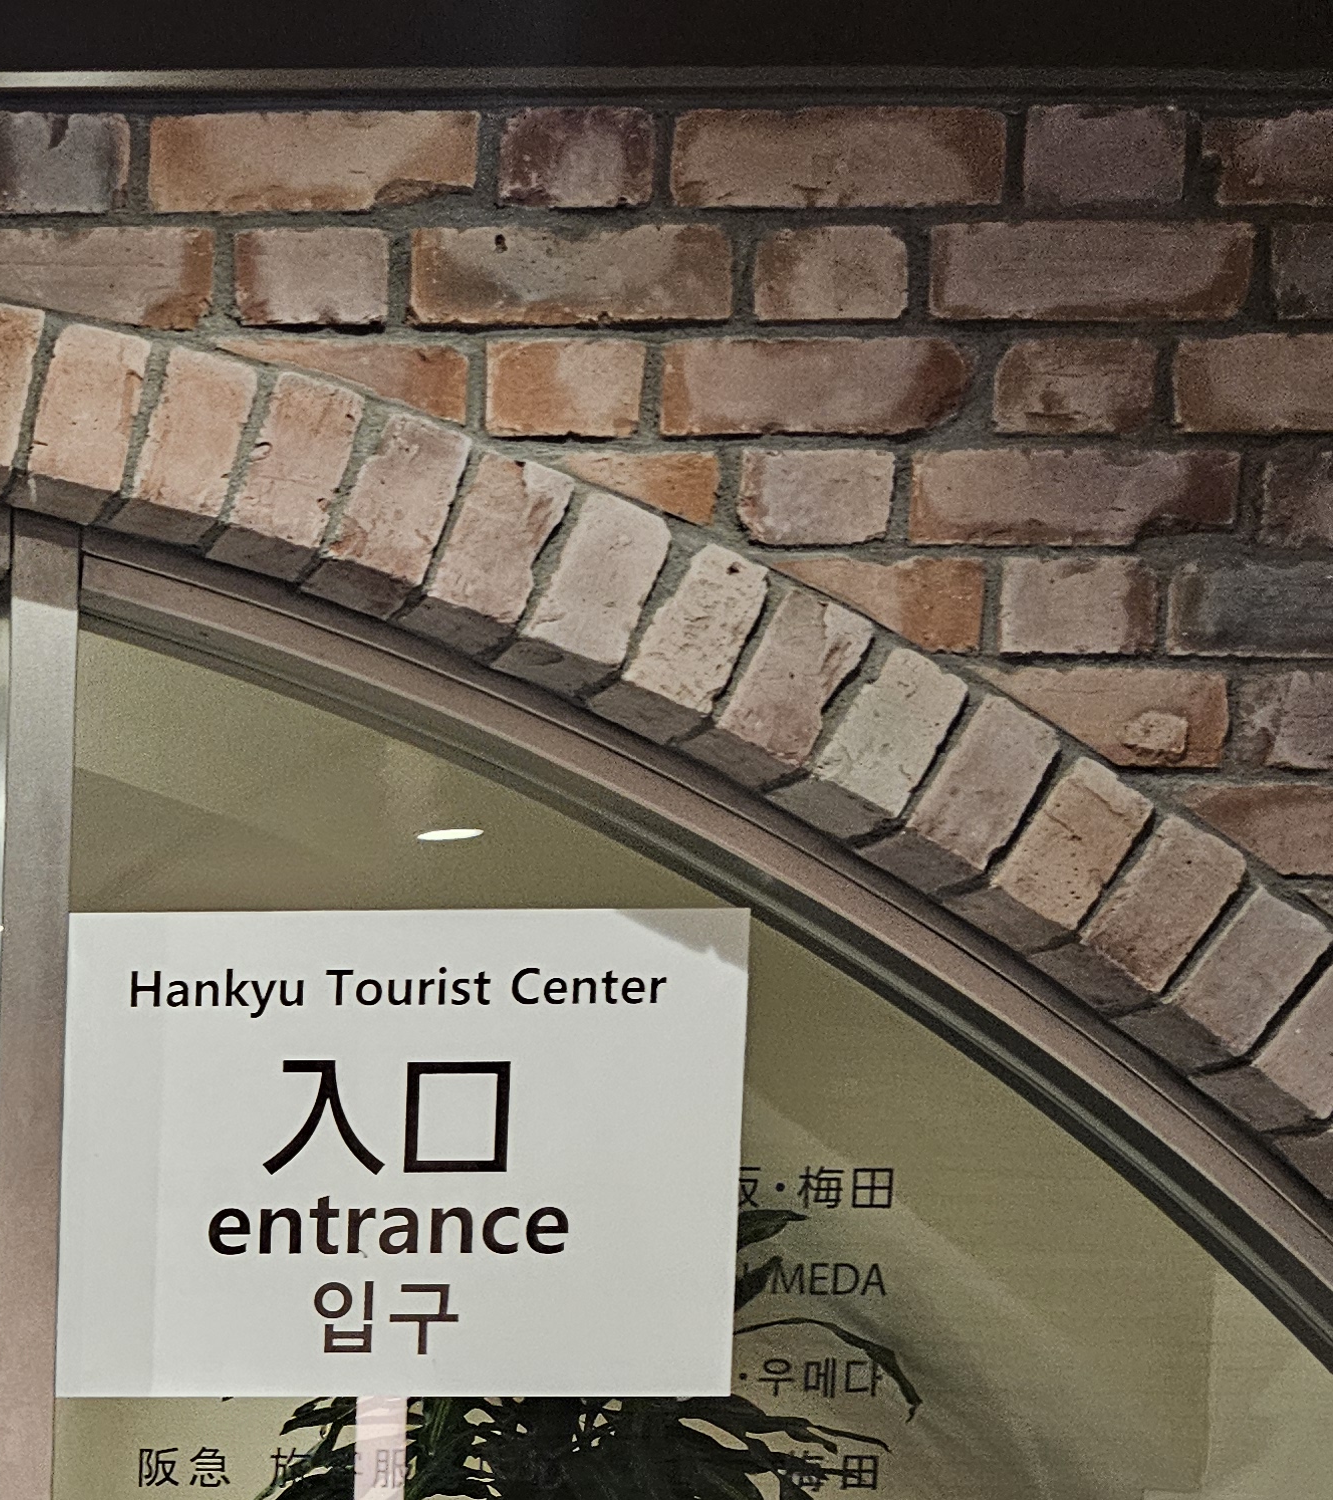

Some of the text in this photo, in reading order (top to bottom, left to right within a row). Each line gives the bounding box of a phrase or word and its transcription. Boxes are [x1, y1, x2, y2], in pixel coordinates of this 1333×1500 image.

[131, 967, 667, 1018] Hankyu Tourist Center
[263, 1060, 511, 1175] 入口
[208, 1196, 568, 1255] entrance
[314, 1281, 459, 1355] 입구
[138, 1446, 231, 1487] 阪急
